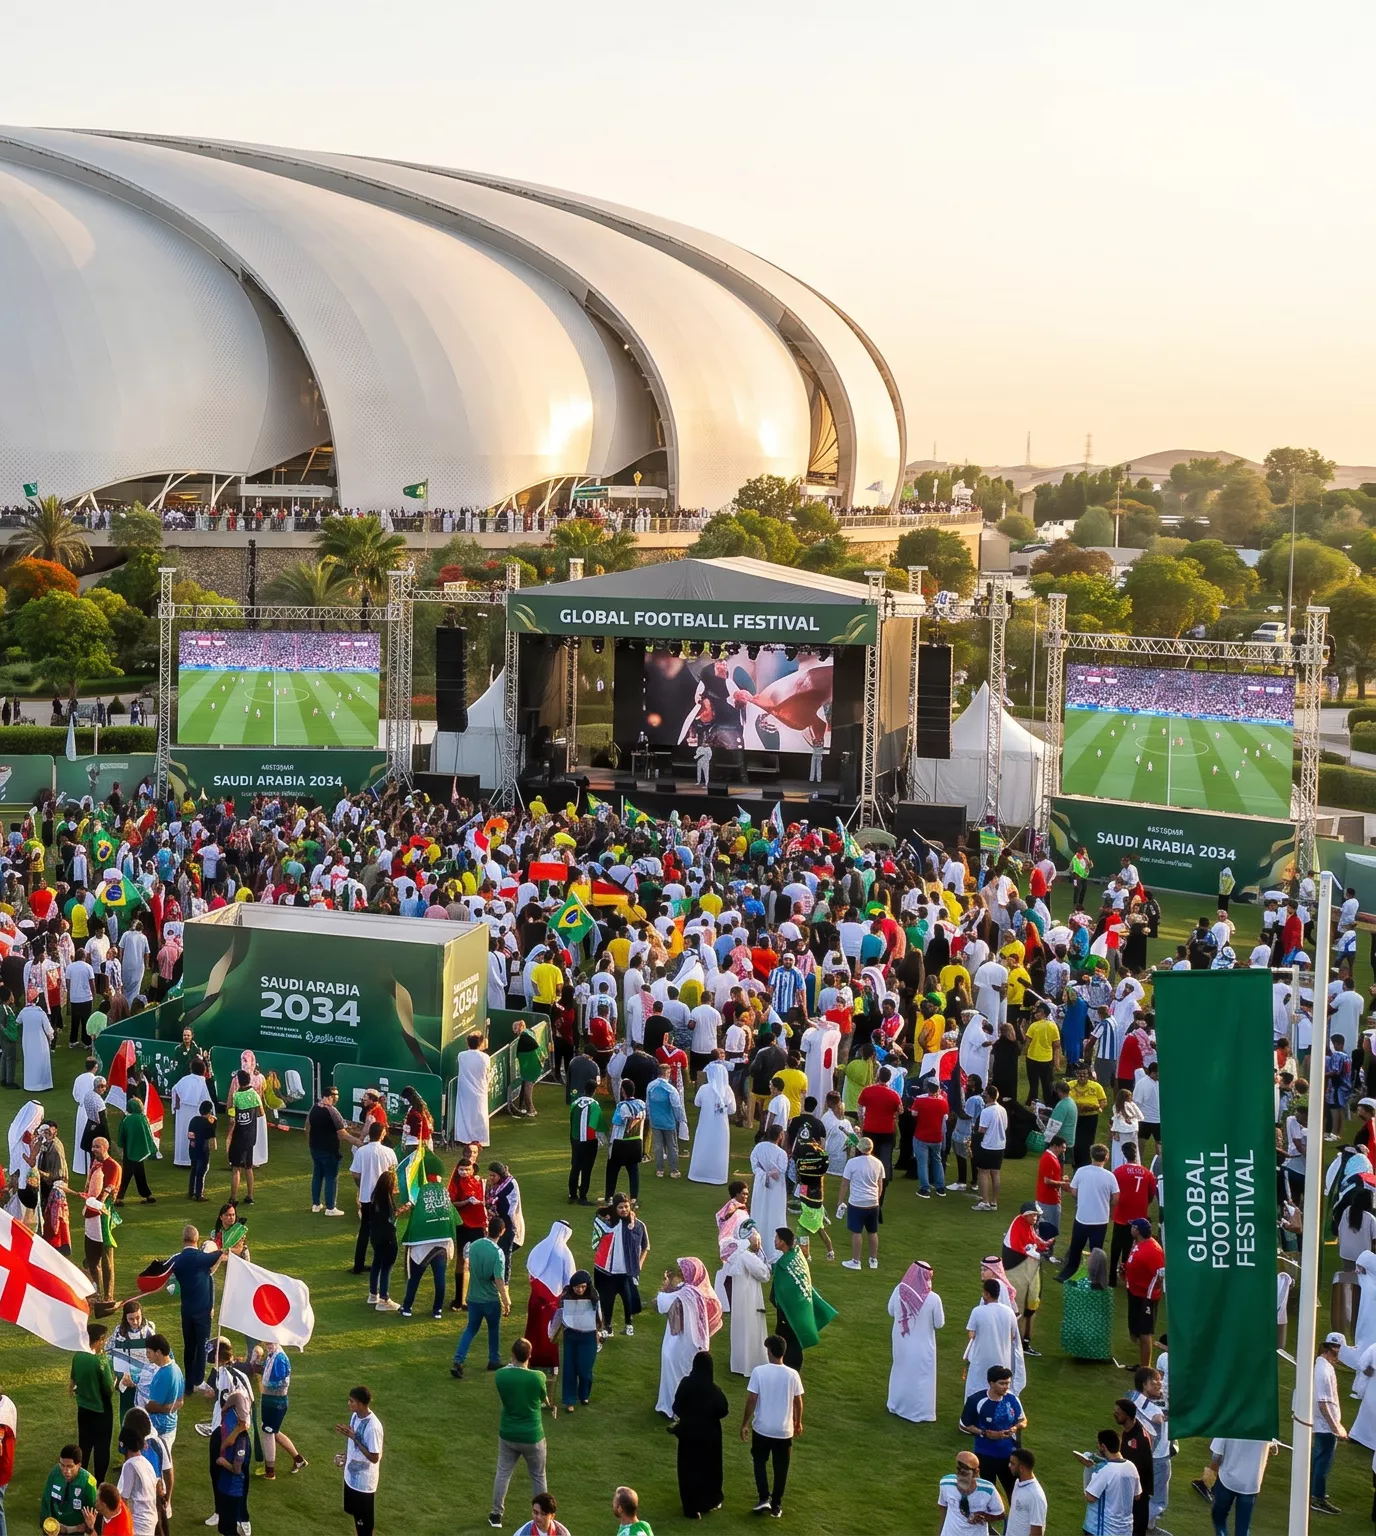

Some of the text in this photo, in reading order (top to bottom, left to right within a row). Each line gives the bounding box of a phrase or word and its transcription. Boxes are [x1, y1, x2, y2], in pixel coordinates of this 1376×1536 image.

[559, 609, 820, 632] GLOBAL FOOTBALL FESTIVAL
[213, 775, 343, 787] SAUDI ARABIA 2034
[1096, 831, 1237, 861] SAUDI ARABIA 2034
[260, 975, 361, 997] SAUDI ARABIA
[260, 991, 361, 1027] 2034
[1185, 1152, 1208, 1262] GLOBAL
[1210, 1144, 1230, 1268] FOOTBALL
[1235, 1150, 1255, 1266] FESTIVAL
